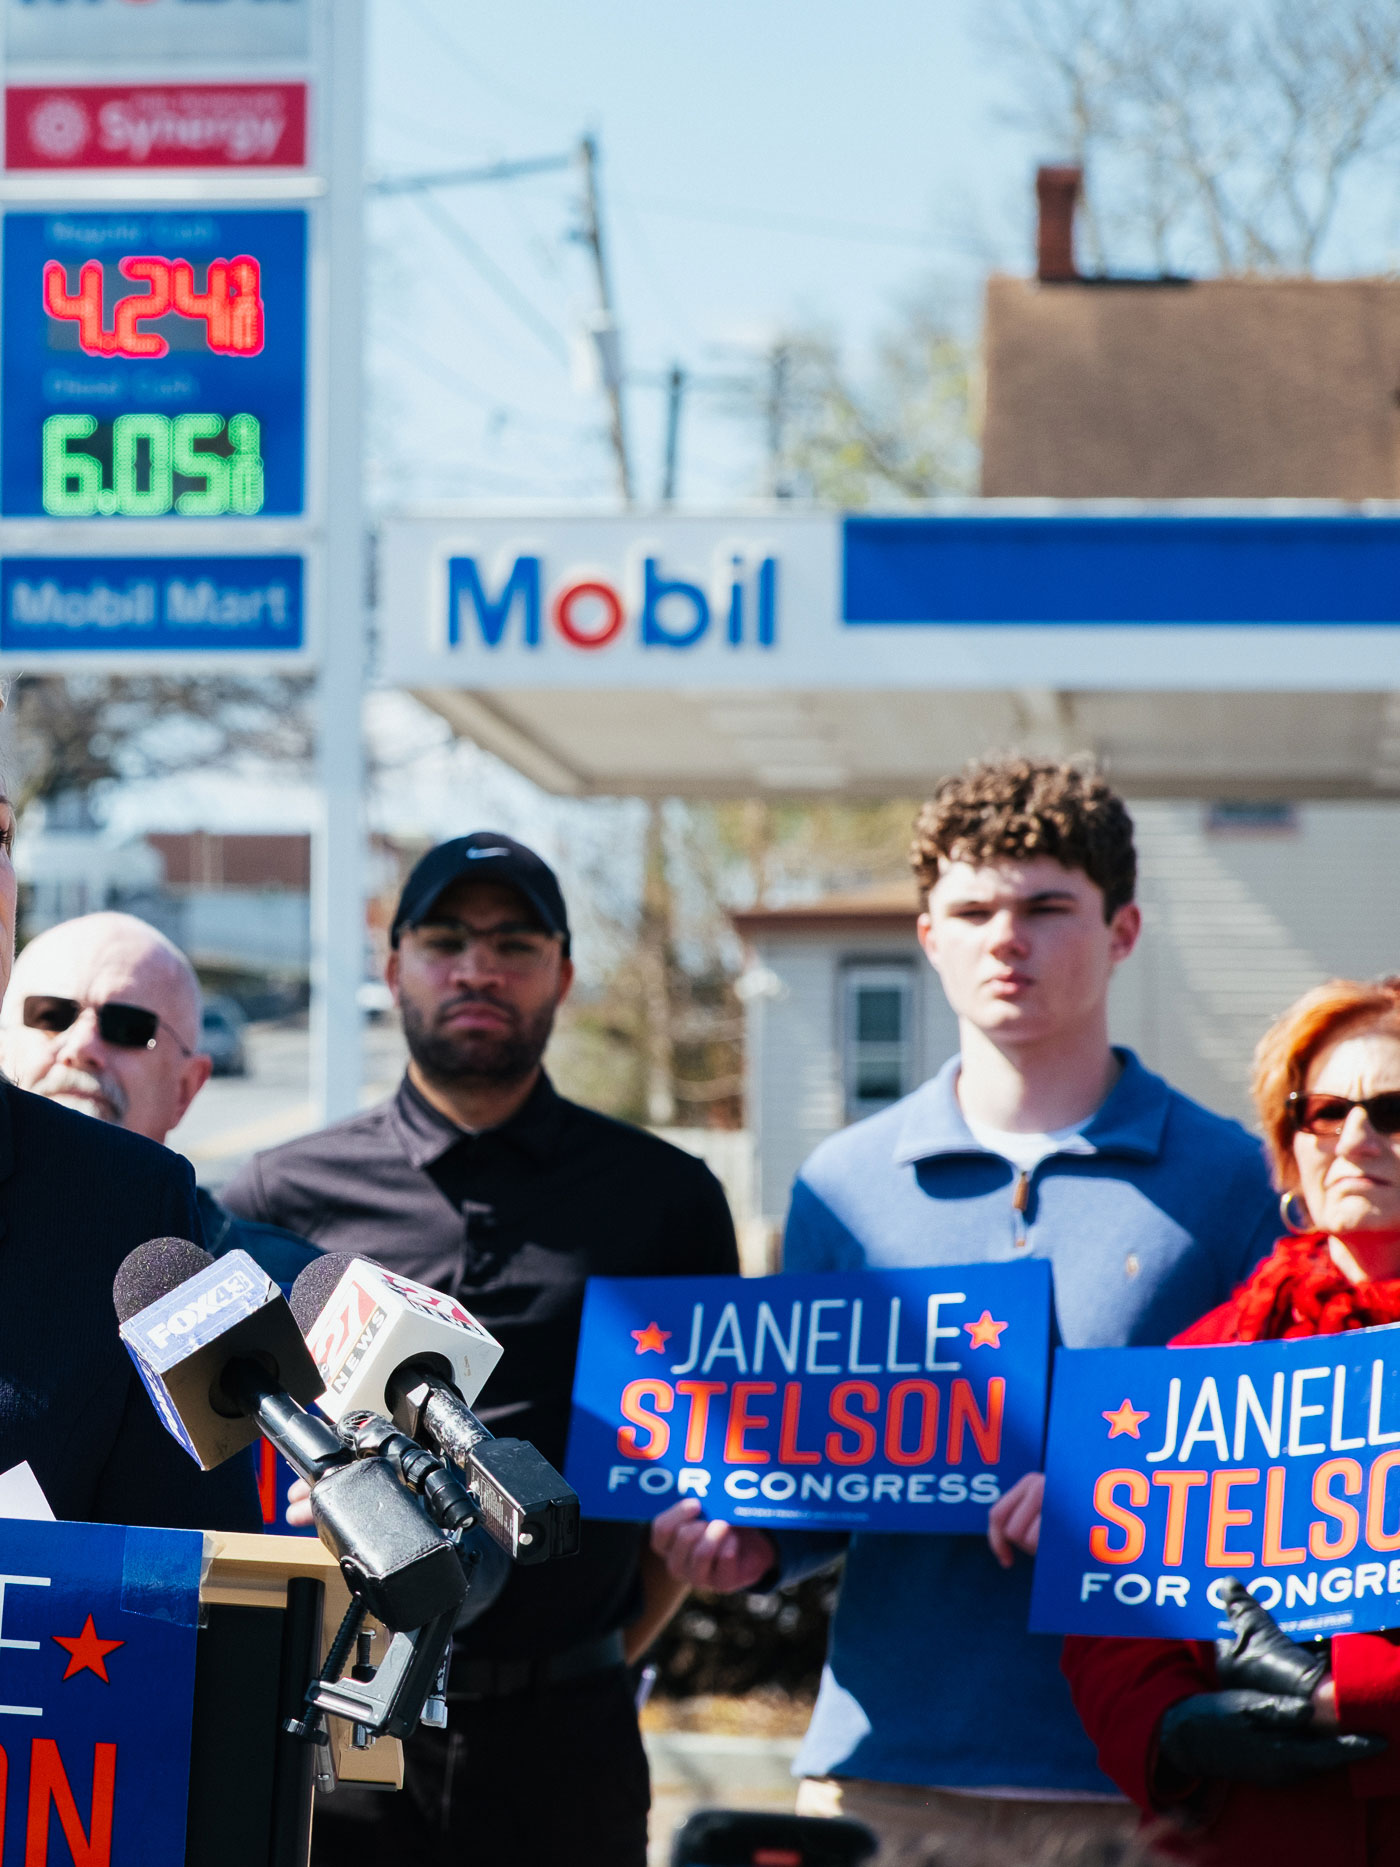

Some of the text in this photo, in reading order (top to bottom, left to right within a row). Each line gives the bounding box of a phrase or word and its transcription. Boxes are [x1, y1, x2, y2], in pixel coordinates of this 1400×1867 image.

[13, 579, 288, 629] Mobil Mart
[448, 556, 775, 650] Mobil
[333, 1309, 386, 1391] NEWS
[670, 1291, 966, 1375] JANELLE
[616, 1377, 1005, 1466] STELSON
[1146, 1359, 1400, 1462] JANELL
[608, 1465, 1001, 1504] FOR CONGRESS
[1089, 1449, 1400, 1568] STELSO
[1080, 1572, 1190, 1608] FOR
